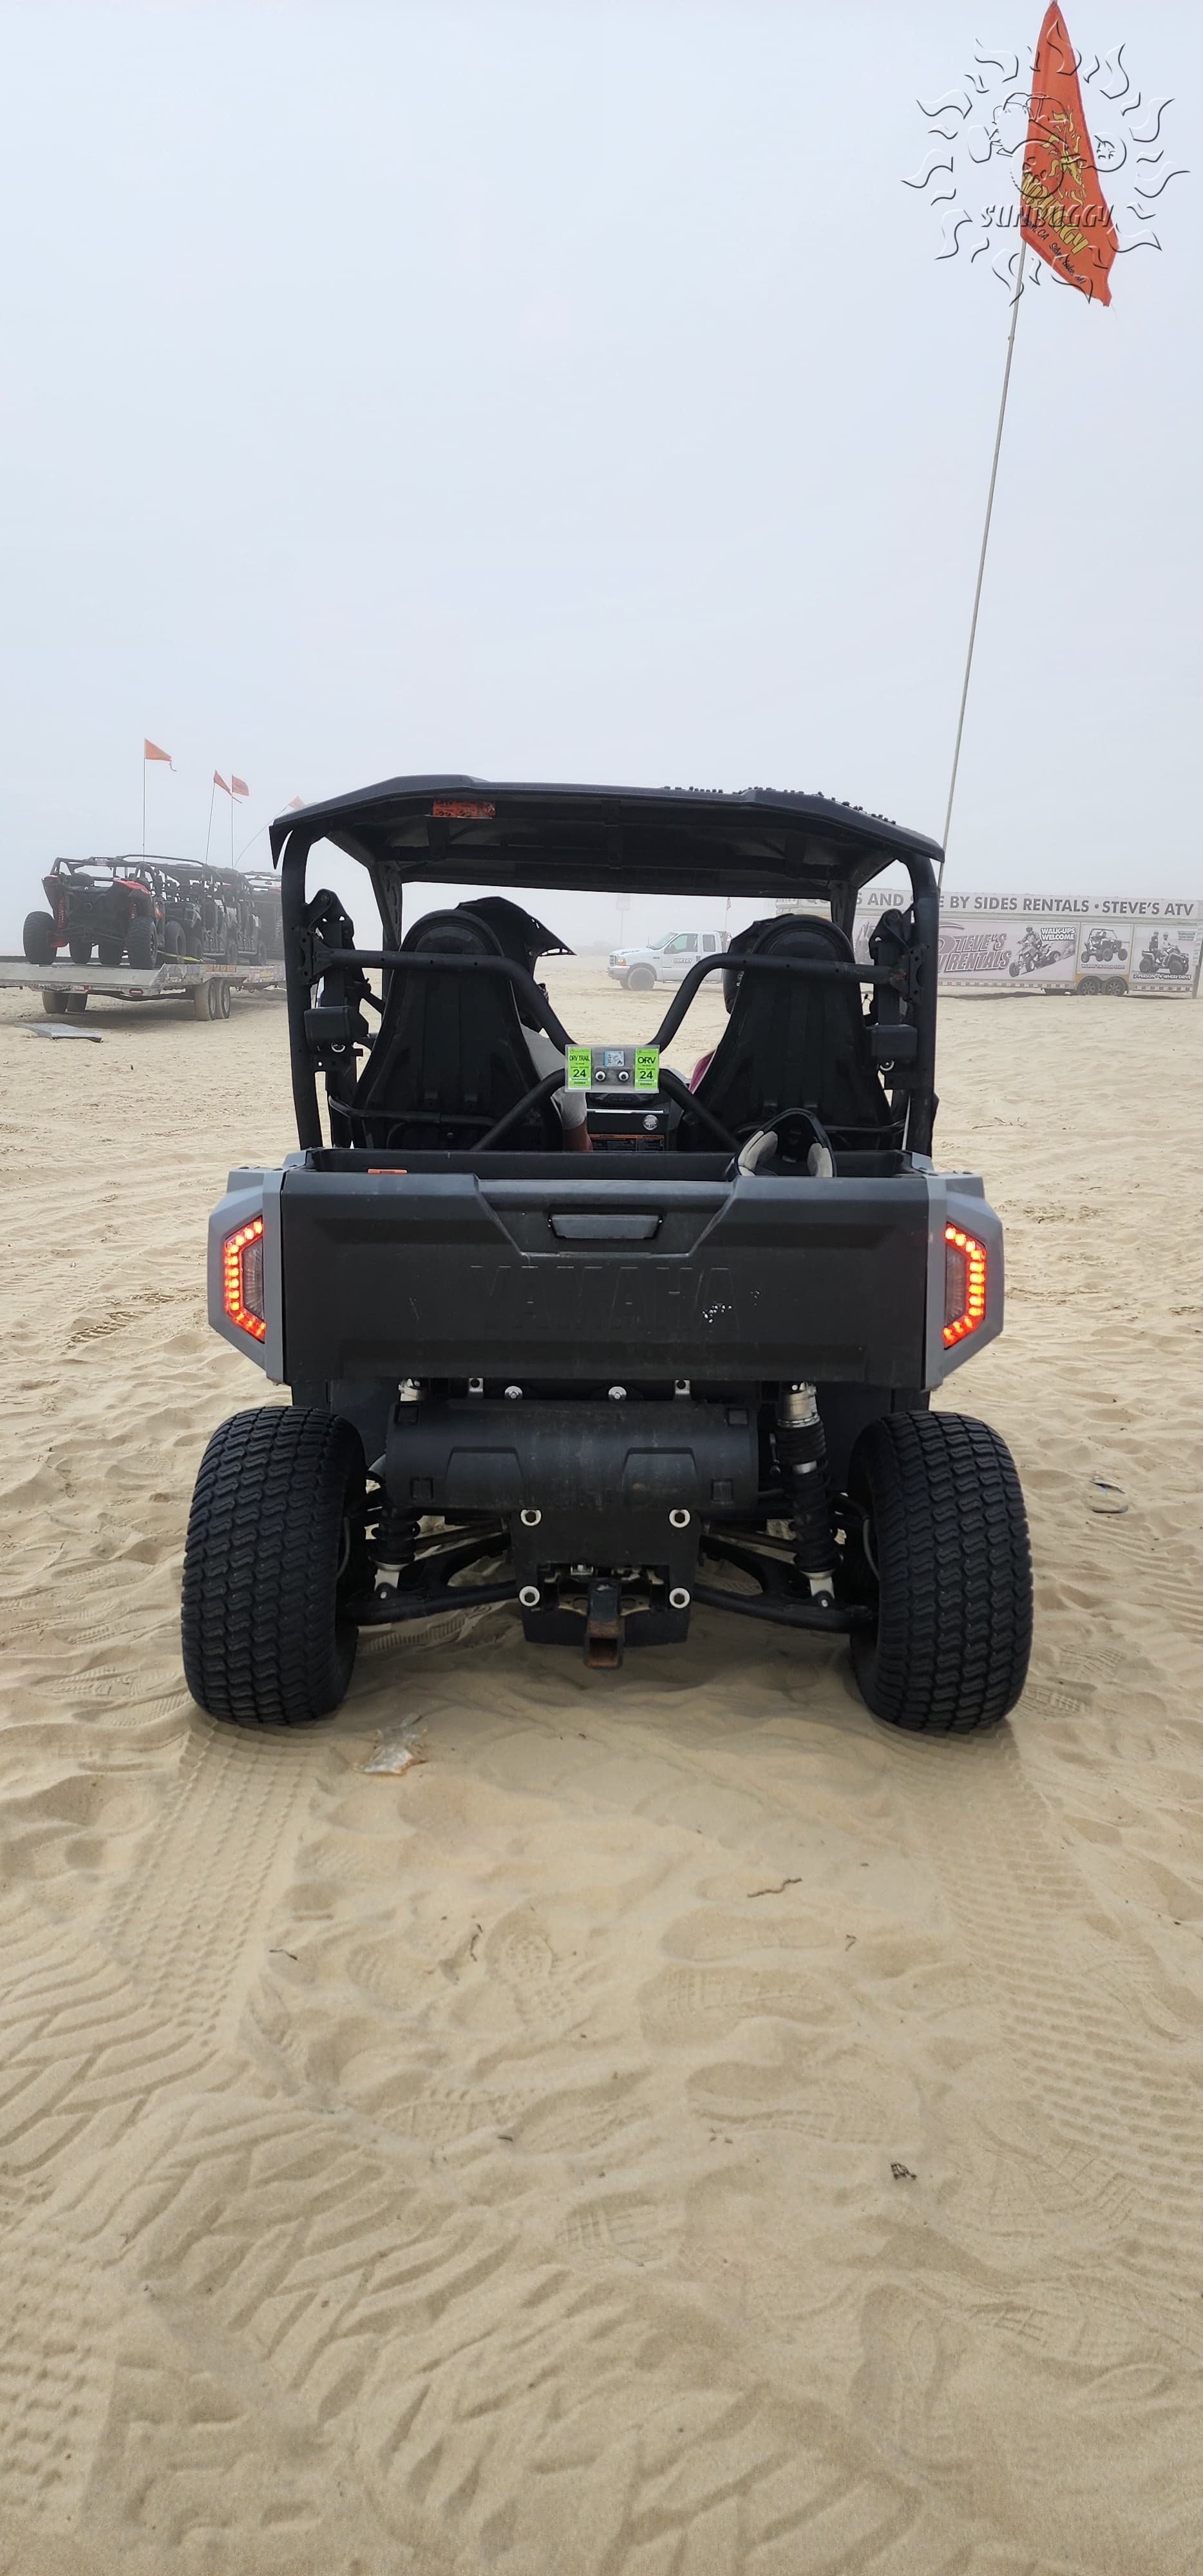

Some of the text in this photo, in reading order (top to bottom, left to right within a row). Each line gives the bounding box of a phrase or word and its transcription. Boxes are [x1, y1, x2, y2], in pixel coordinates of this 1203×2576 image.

[867, 893, 904, 906] AND
[950, 896, 970, 909] BY
[974, 896, 1018, 911] SIDES
[1023, 898, 1090, 913] RENTALS
[1102, 900, 1195, 916] STEVE'S ATV
[943, 950, 1012, 972] RENTALS
[573, 1069, 586, 1077] 24
[639, 1071, 653, 1079] 24
[469, 1265, 739, 1331] YAMAHA
